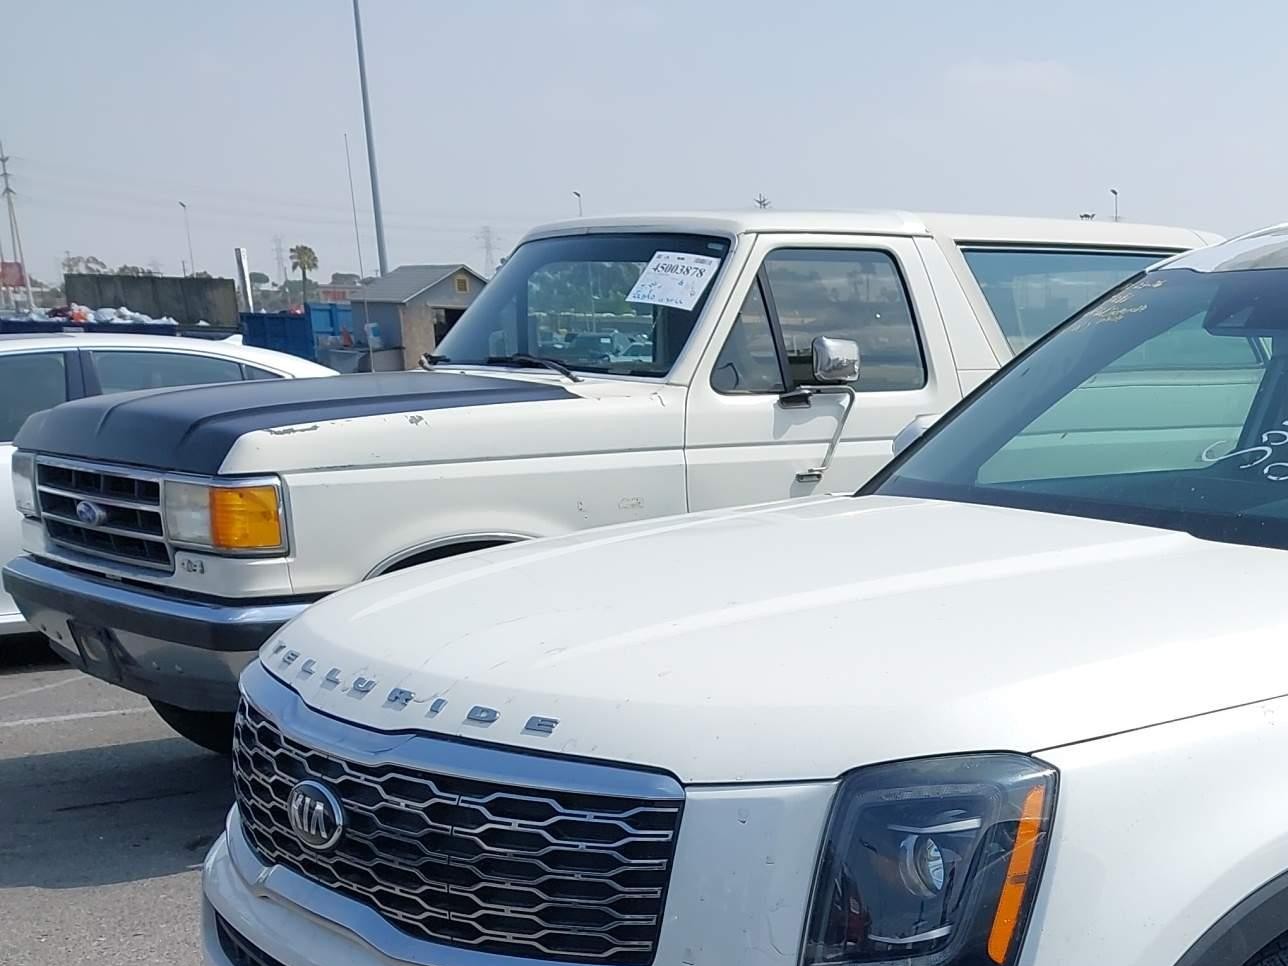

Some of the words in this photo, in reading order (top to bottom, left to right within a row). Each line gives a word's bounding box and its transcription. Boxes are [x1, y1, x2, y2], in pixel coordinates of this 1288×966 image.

[652, 262, 706, 278] 45003878
[272, 640, 560, 734] TELLURIDE
[292, 790, 328, 839] KIA
